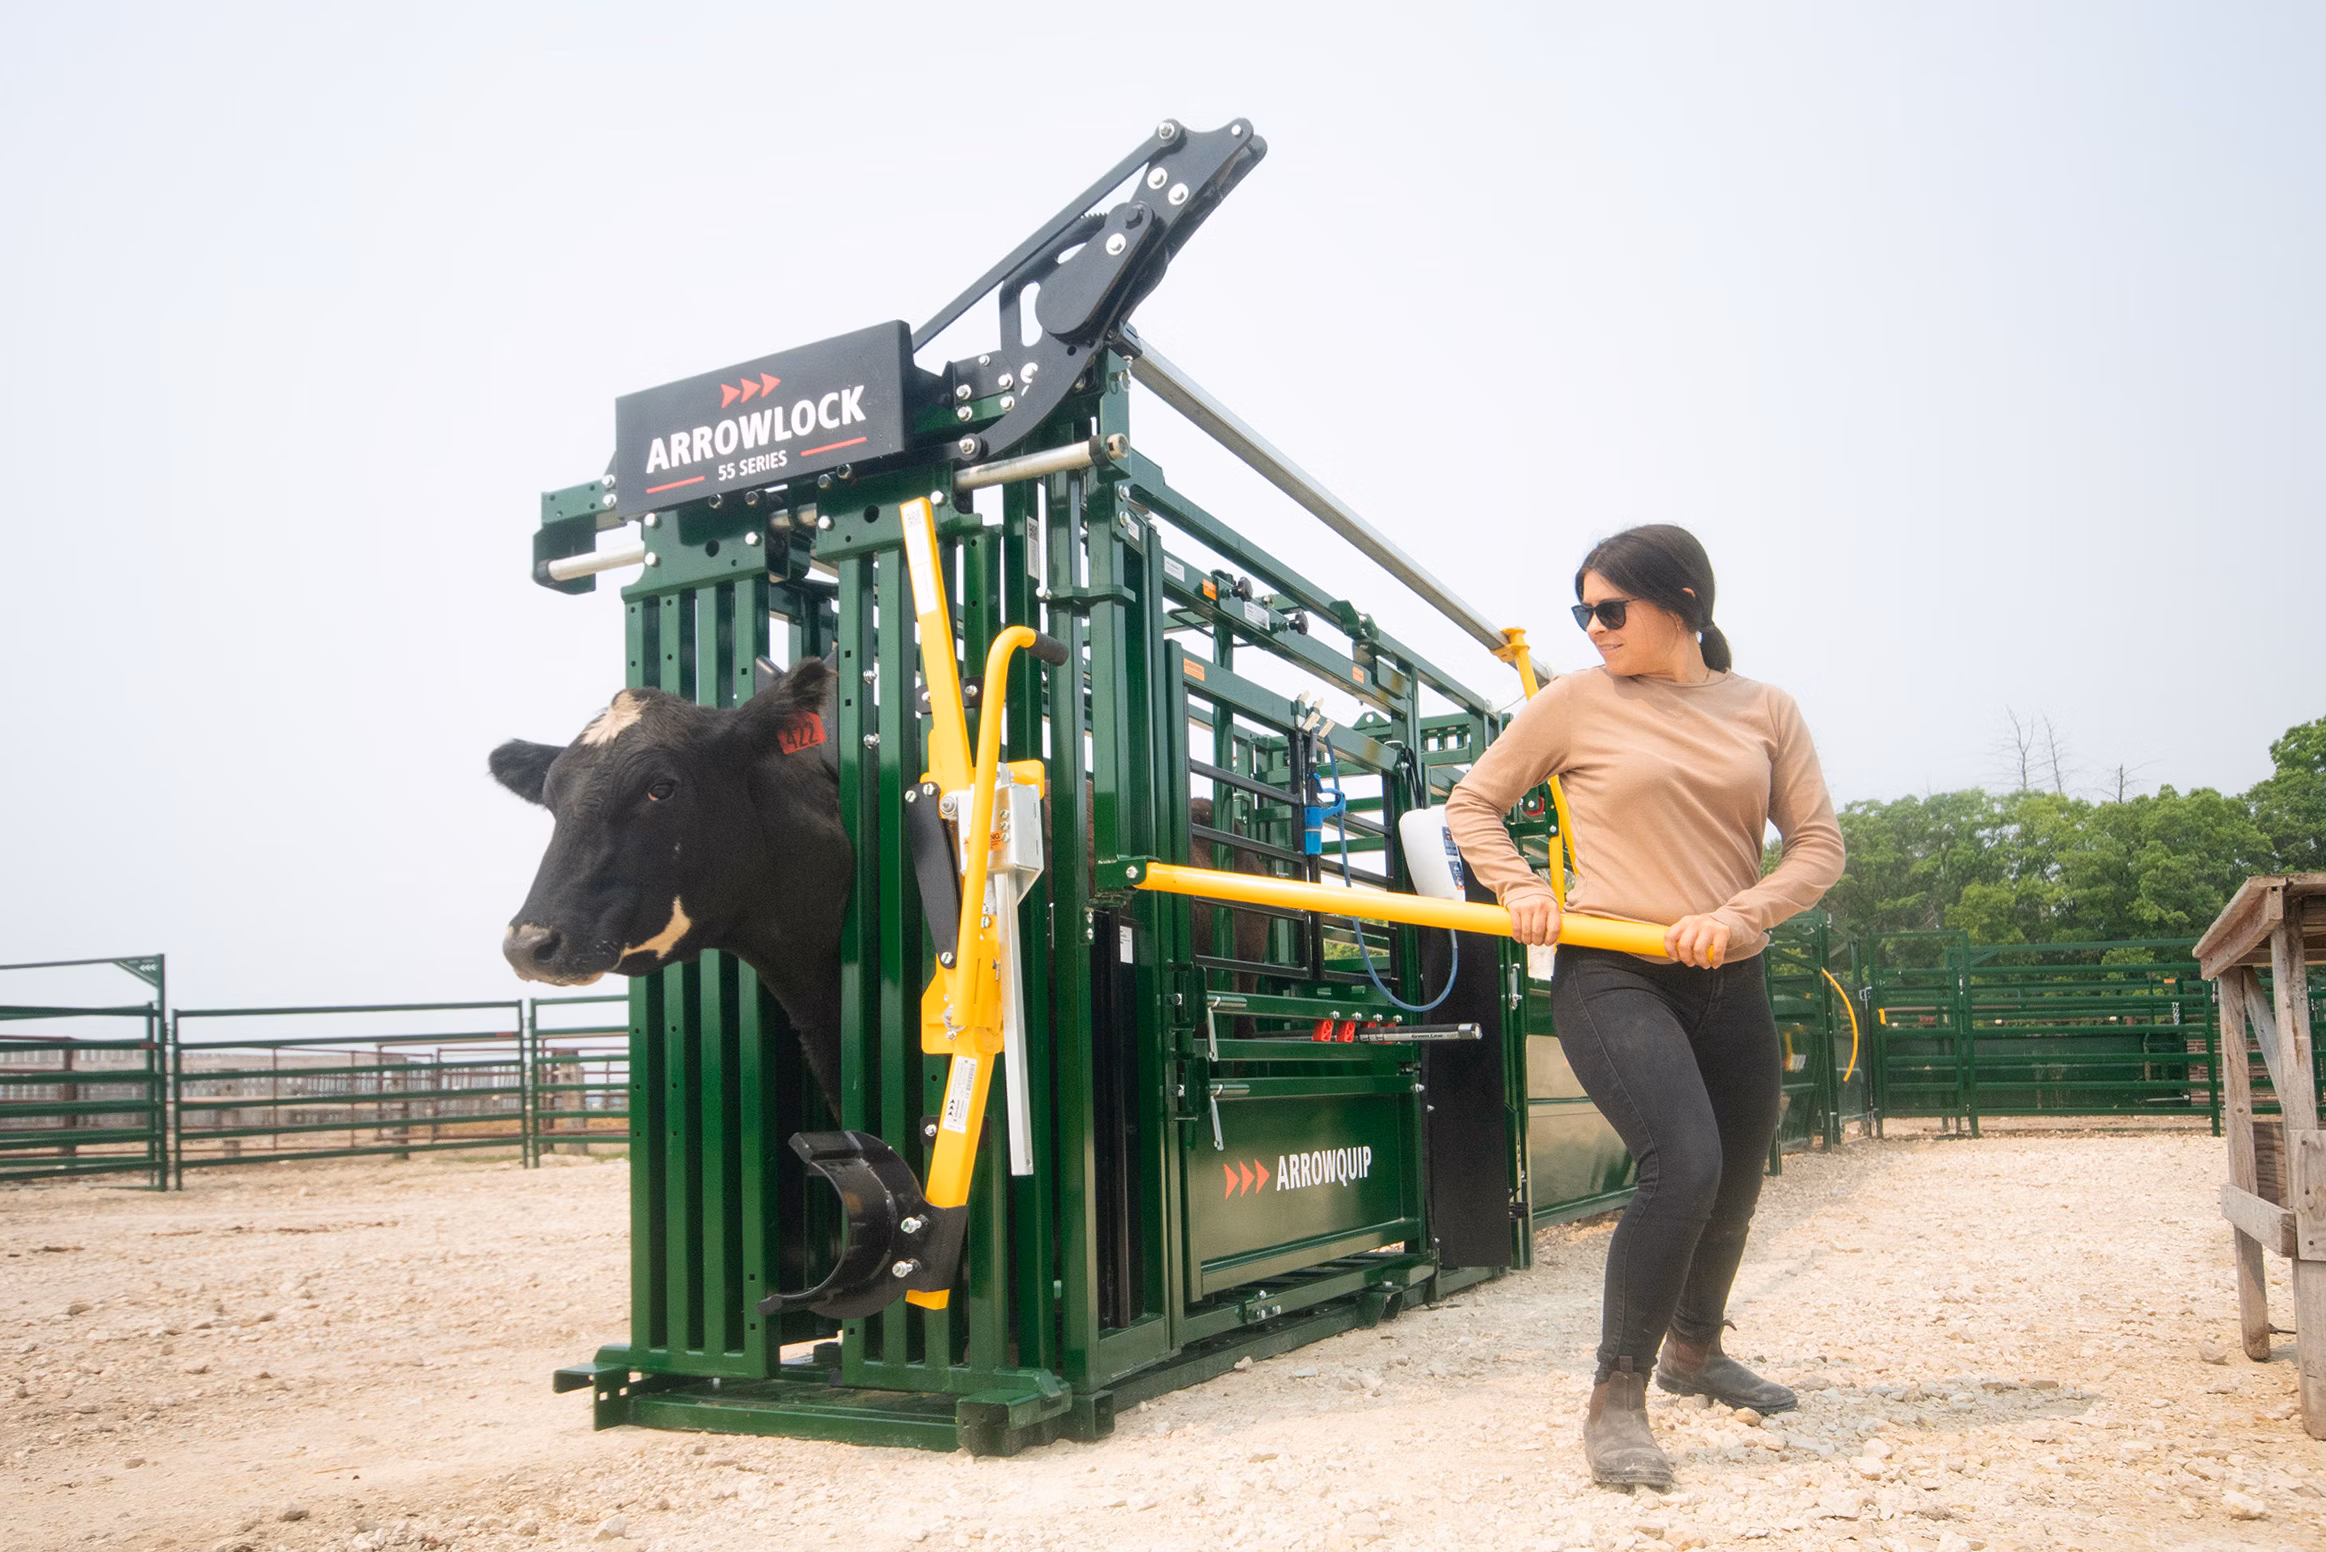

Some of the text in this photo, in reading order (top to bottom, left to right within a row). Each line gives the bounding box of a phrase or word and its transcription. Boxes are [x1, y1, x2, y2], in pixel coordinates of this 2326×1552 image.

[646, 385, 867, 474] ARROWLOCK
[718, 450, 788, 482] 55 SERIES
[786, 721, 819, 749] 422
[1276, 1146, 1372, 1191] ARROWQUIP
